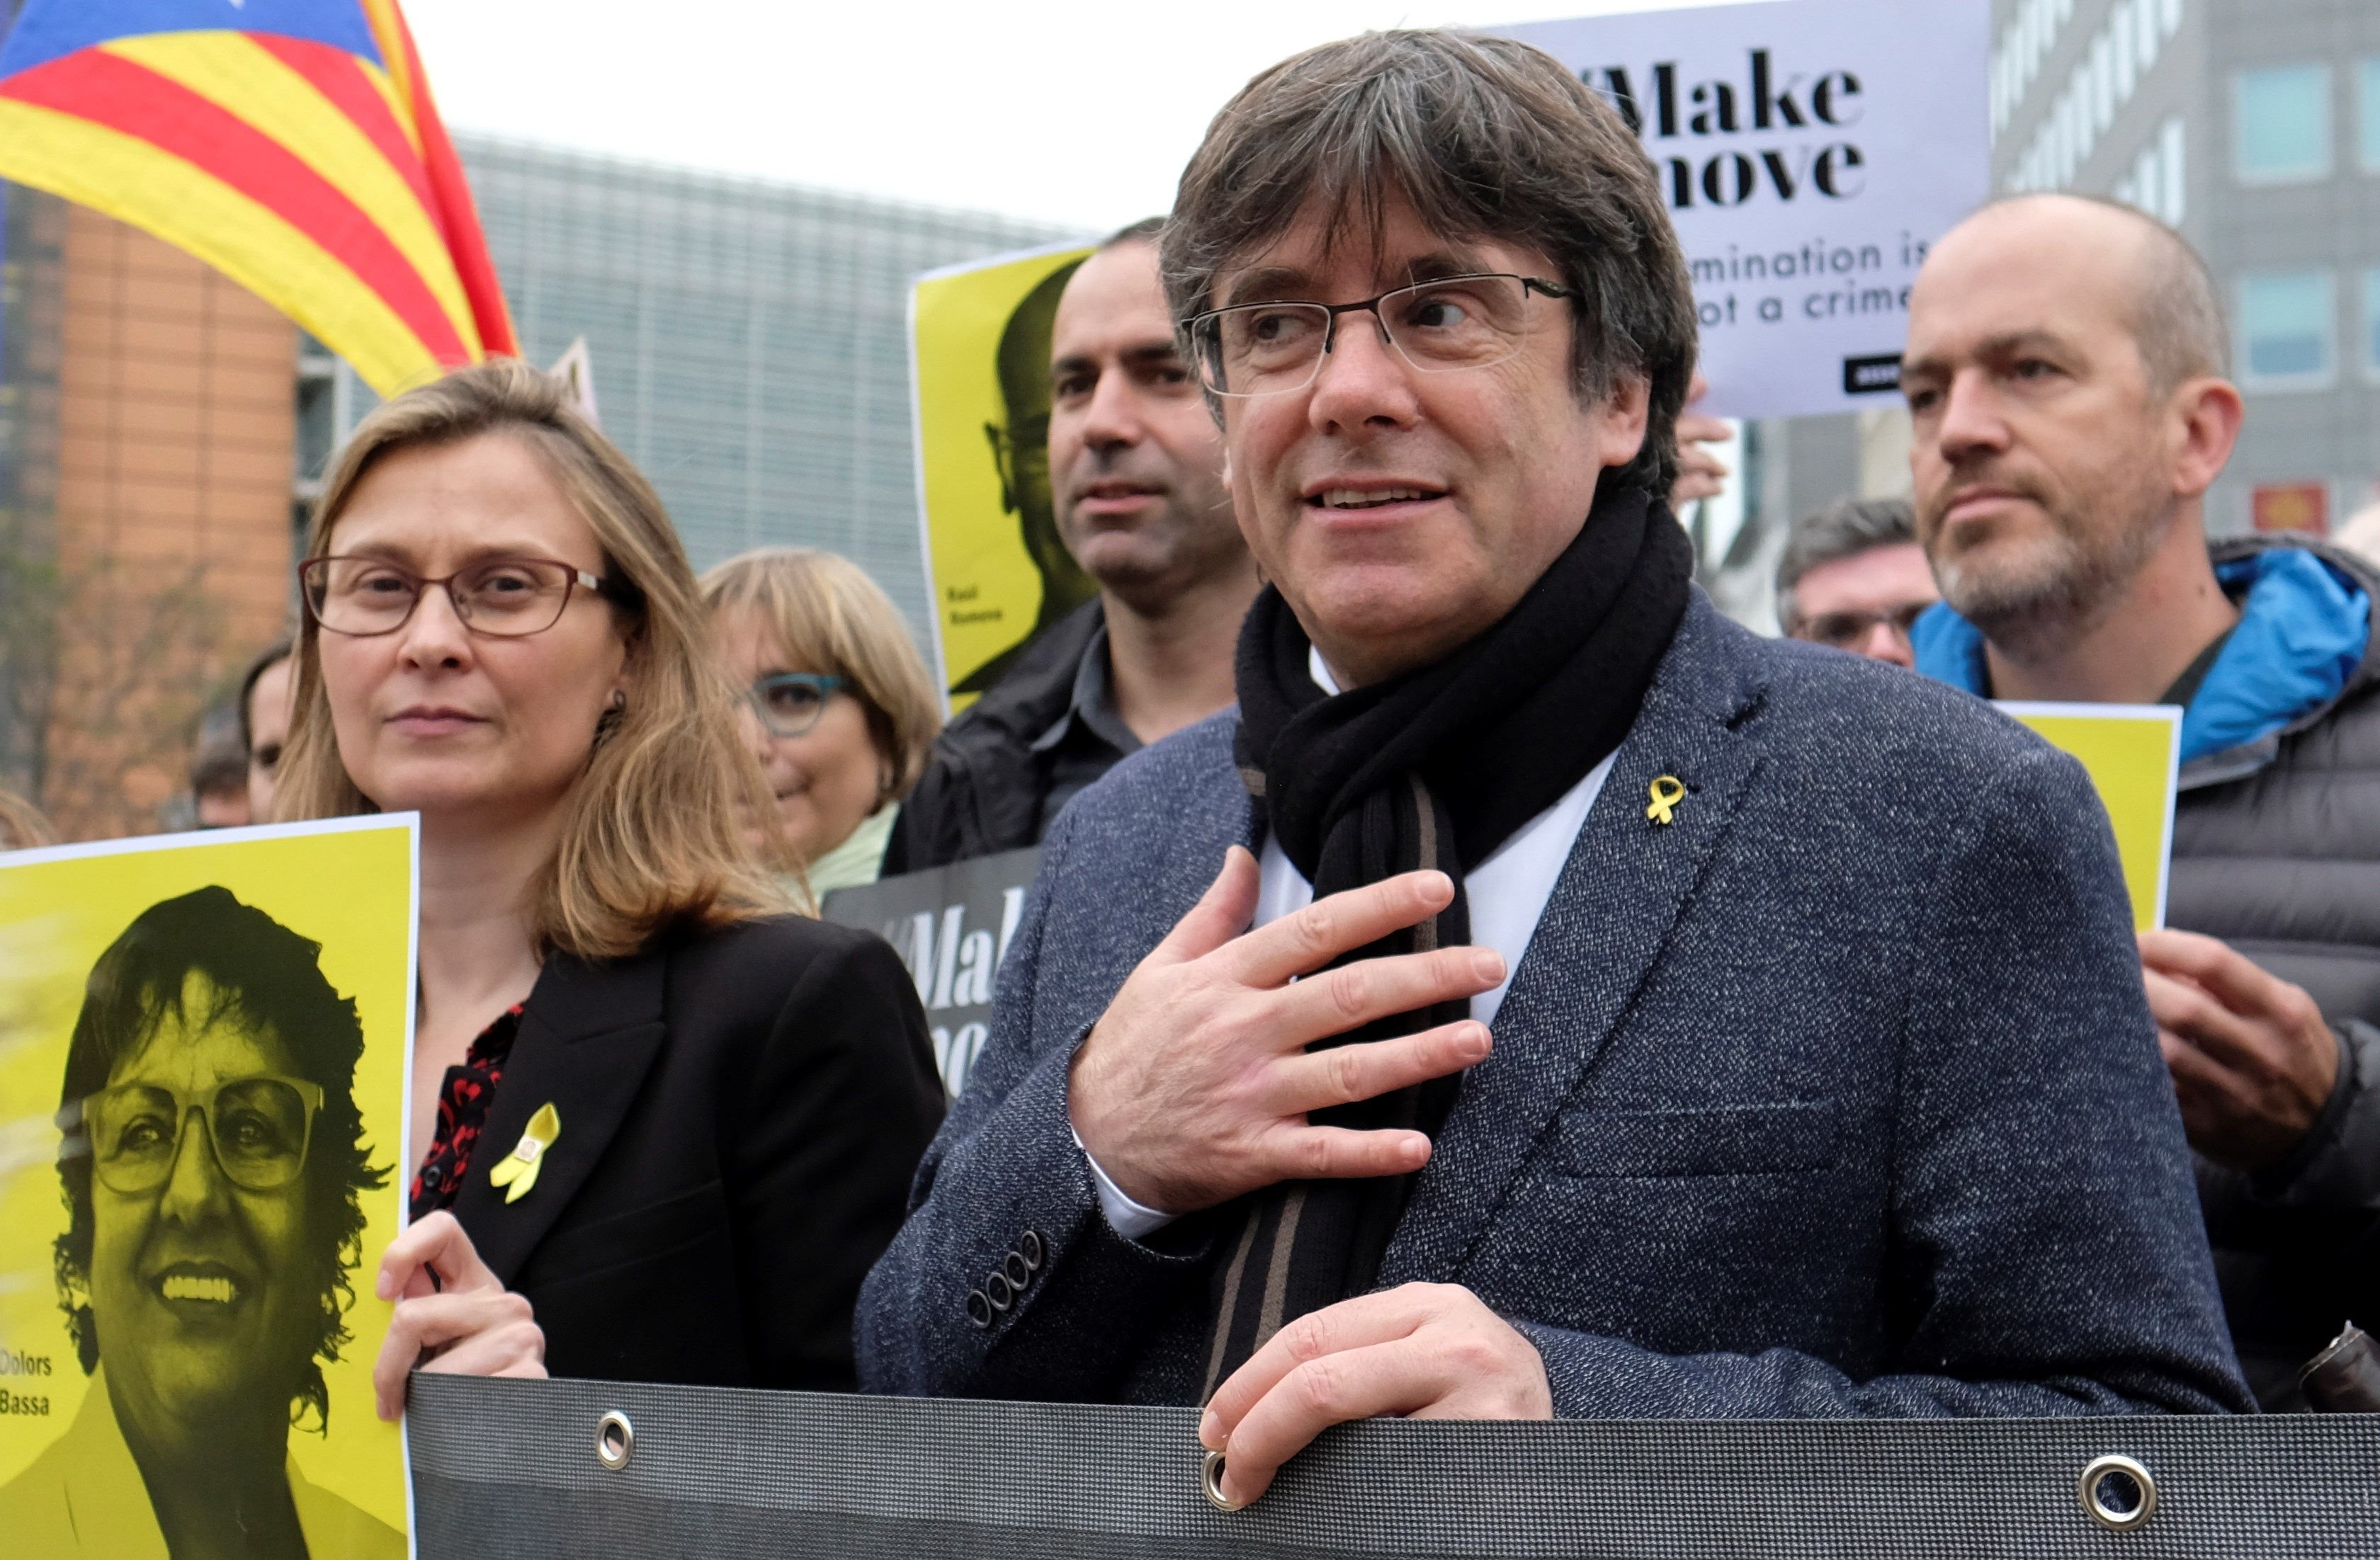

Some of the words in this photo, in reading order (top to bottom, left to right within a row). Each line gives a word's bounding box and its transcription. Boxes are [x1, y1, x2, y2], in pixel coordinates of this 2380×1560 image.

[1580, 49, 1865, 137] Make
[1759, 296, 1783, 322] a
[0, 1388, 50, 1416] Bassa
